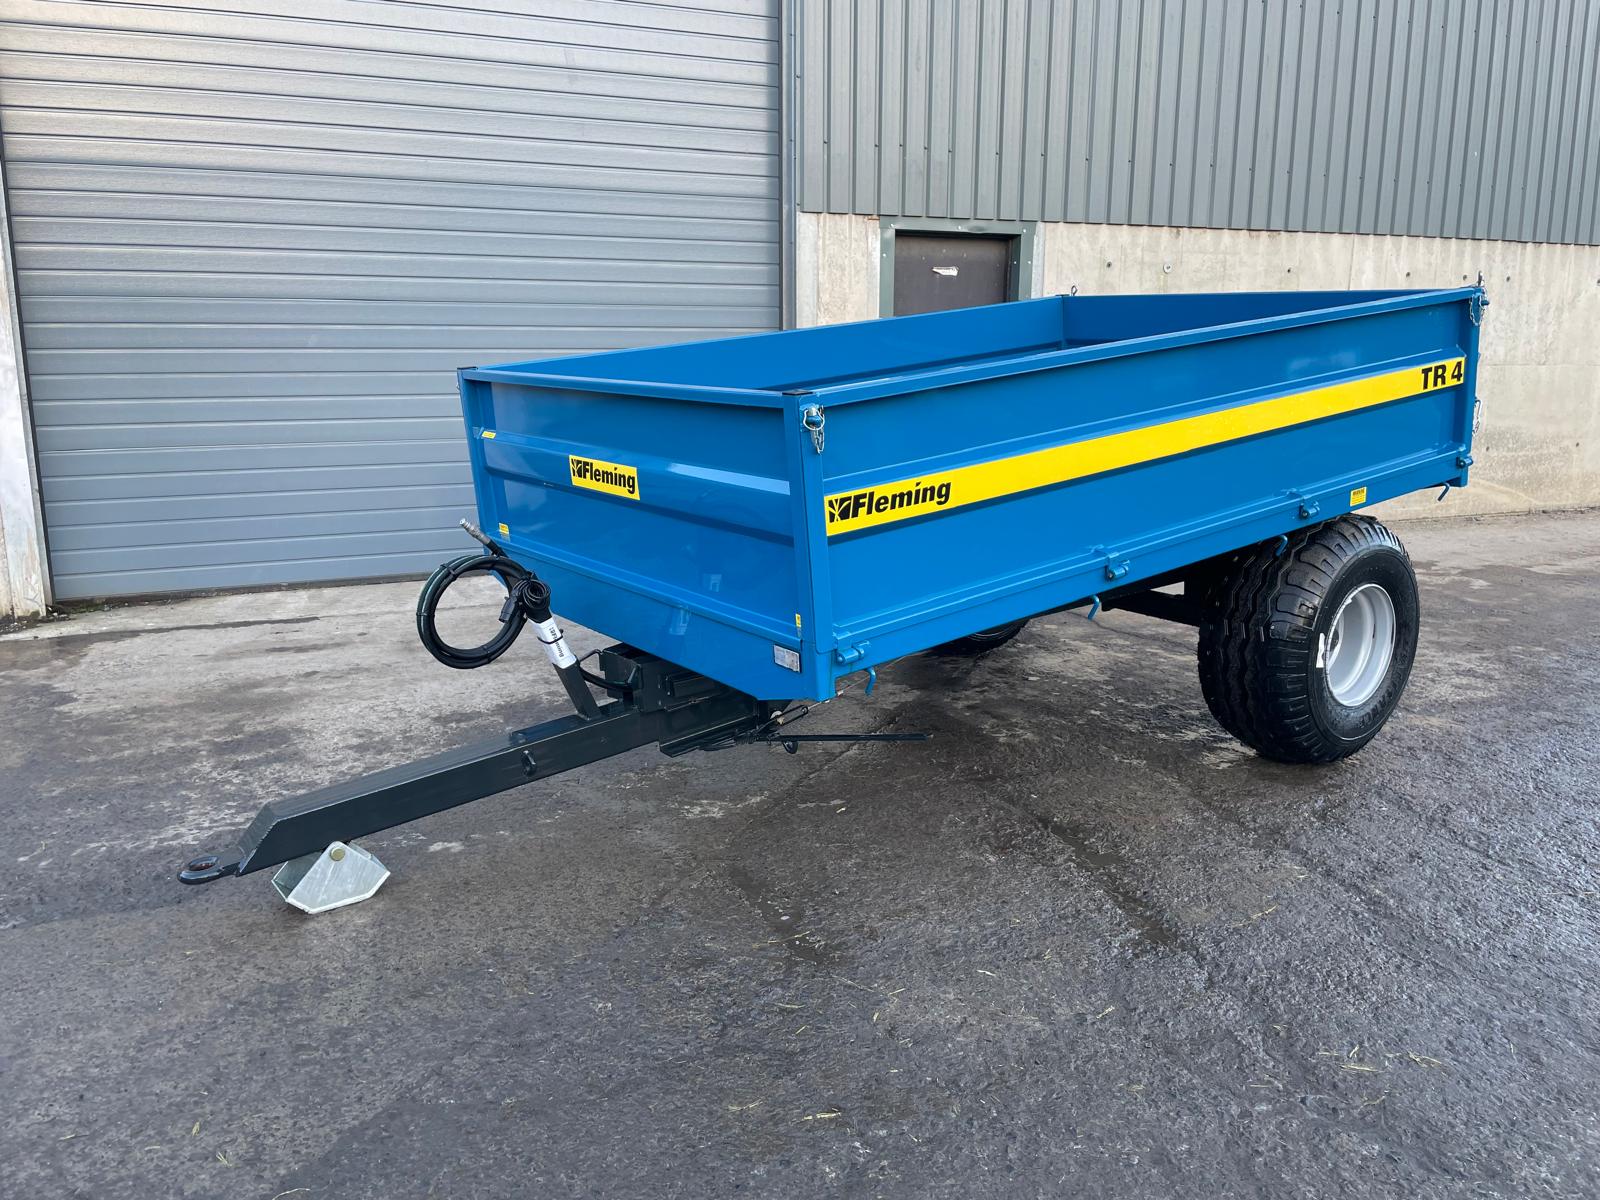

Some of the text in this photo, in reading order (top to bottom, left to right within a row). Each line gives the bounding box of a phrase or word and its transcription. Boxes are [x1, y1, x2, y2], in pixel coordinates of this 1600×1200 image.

[1421, 361, 1463, 390] TR 4
[582, 461, 636, 495] Fleming
[851, 481, 952, 519] Fleming
